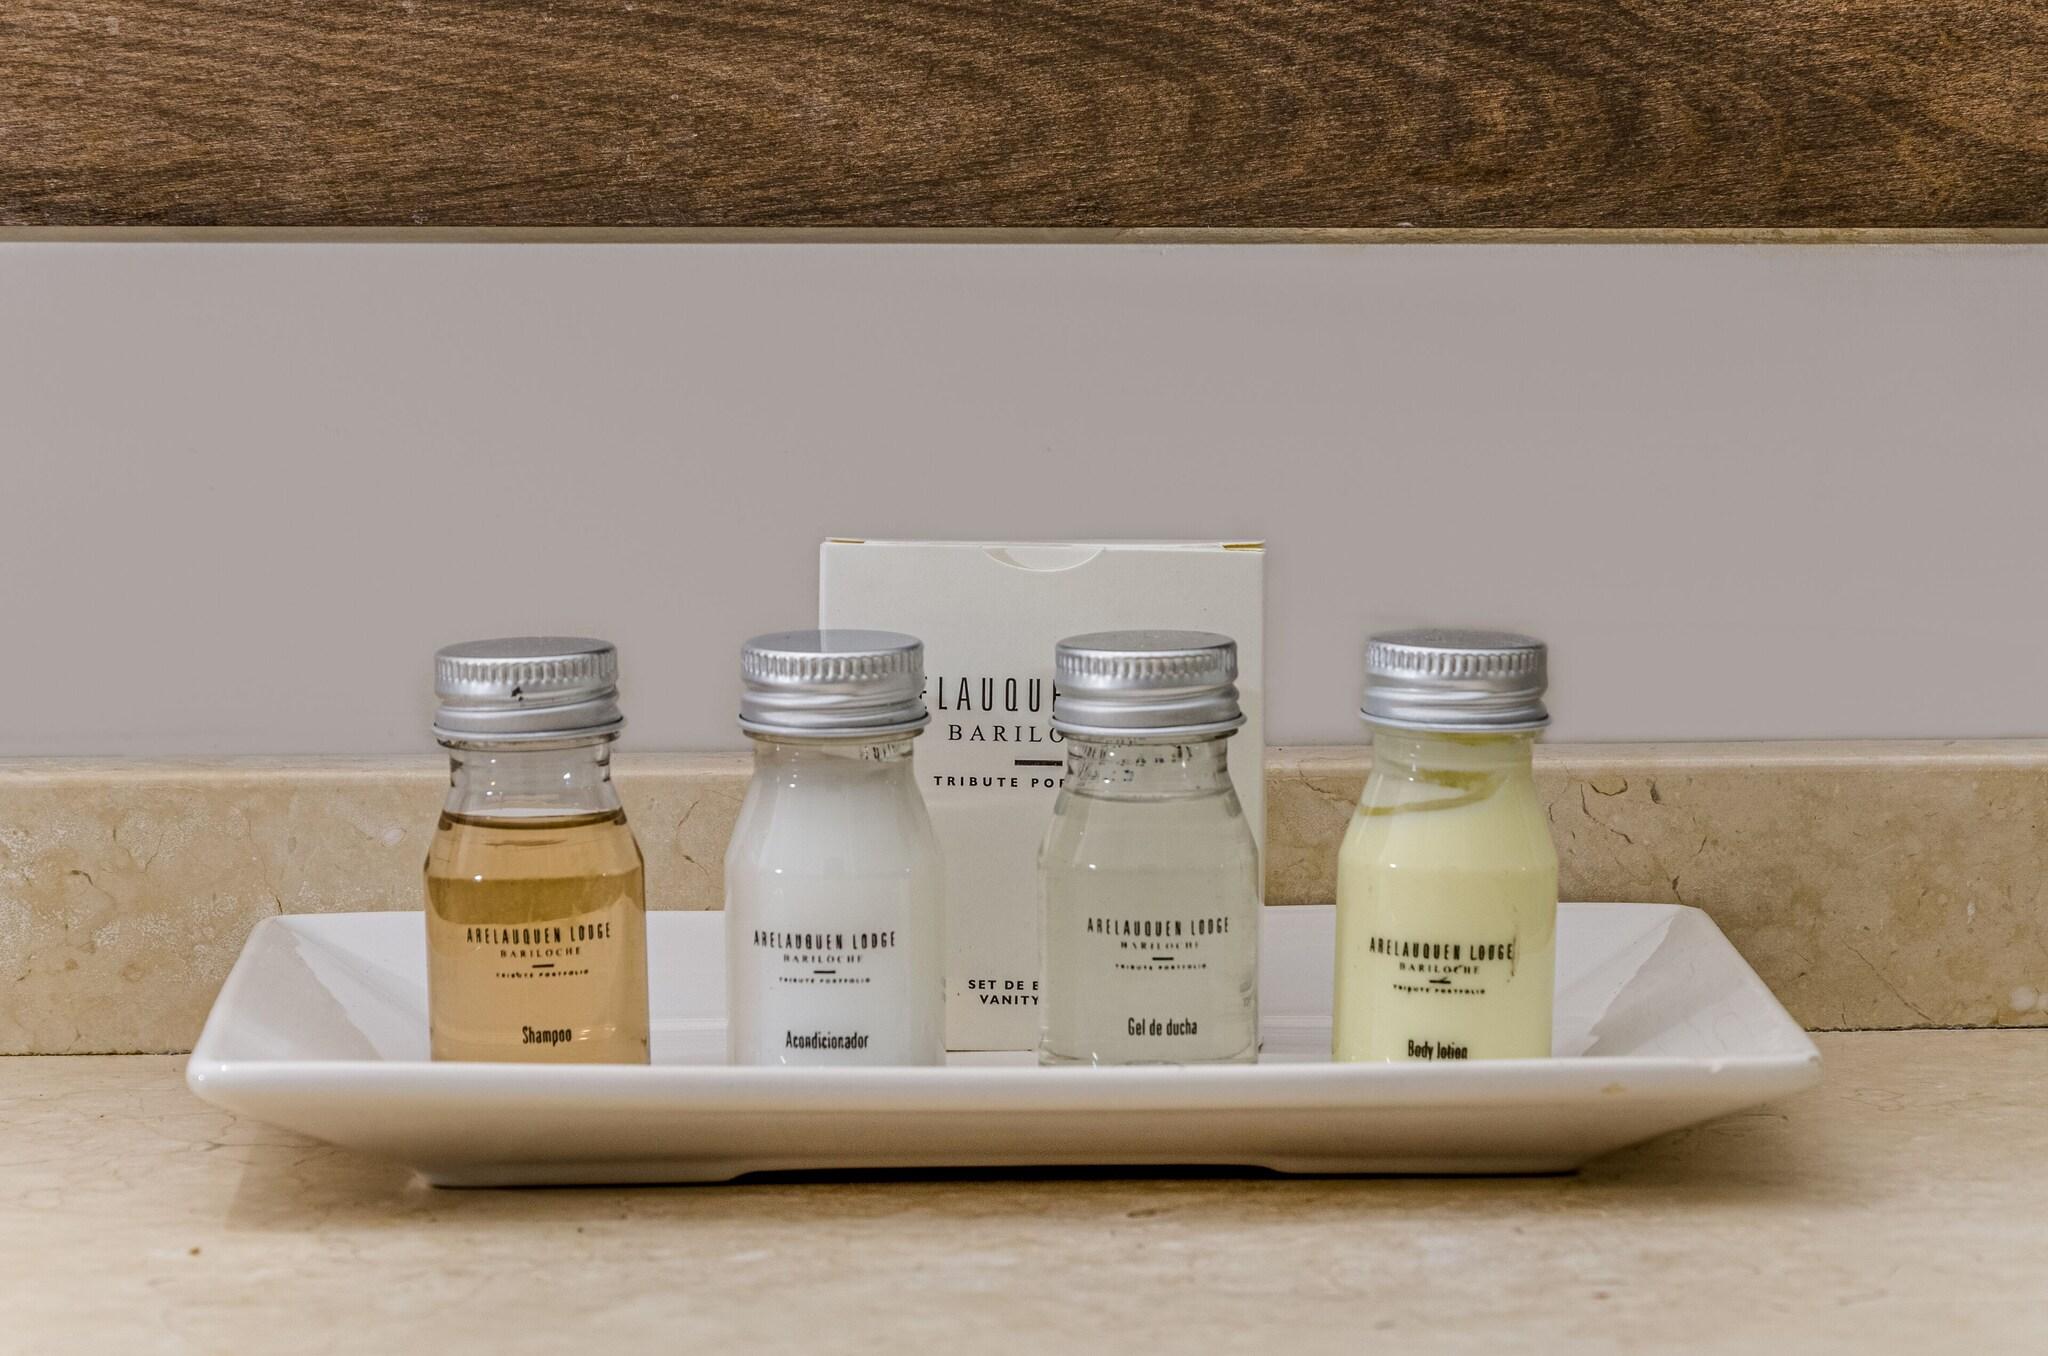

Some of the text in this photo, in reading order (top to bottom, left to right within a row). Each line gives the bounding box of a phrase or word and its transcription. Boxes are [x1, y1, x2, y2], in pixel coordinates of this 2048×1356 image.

[934, 776, 1018, 788] TRIBUTE
[467, 922, 611, 945] ARELAUQUEN LODGE
[1087, 916, 1229, 937] ARELAUQUEN LODGE
[753, 930, 896, 950] ARELAUQUEN LODGE
[1369, 936, 1513, 960] ARELAUQUEN LODGE
[500, 946, 581, 959] BARILOCHE
[783, 954, 863, 964] BARILOCHE
[1399, 961, 1480, 975] BARILOCHE
[968, 979, 997, 990] SET
[1004, 980, 1025, 991] DE
[979, 994, 1039, 1006] VANITY
[522, 1025, 572, 1047] Shampoo
[1128, 1016, 1198, 1036] Gel de ducha
[785, 1029, 869, 1050] Acondicionador
[1407, 1039, 1469, 1061] Body lotion
